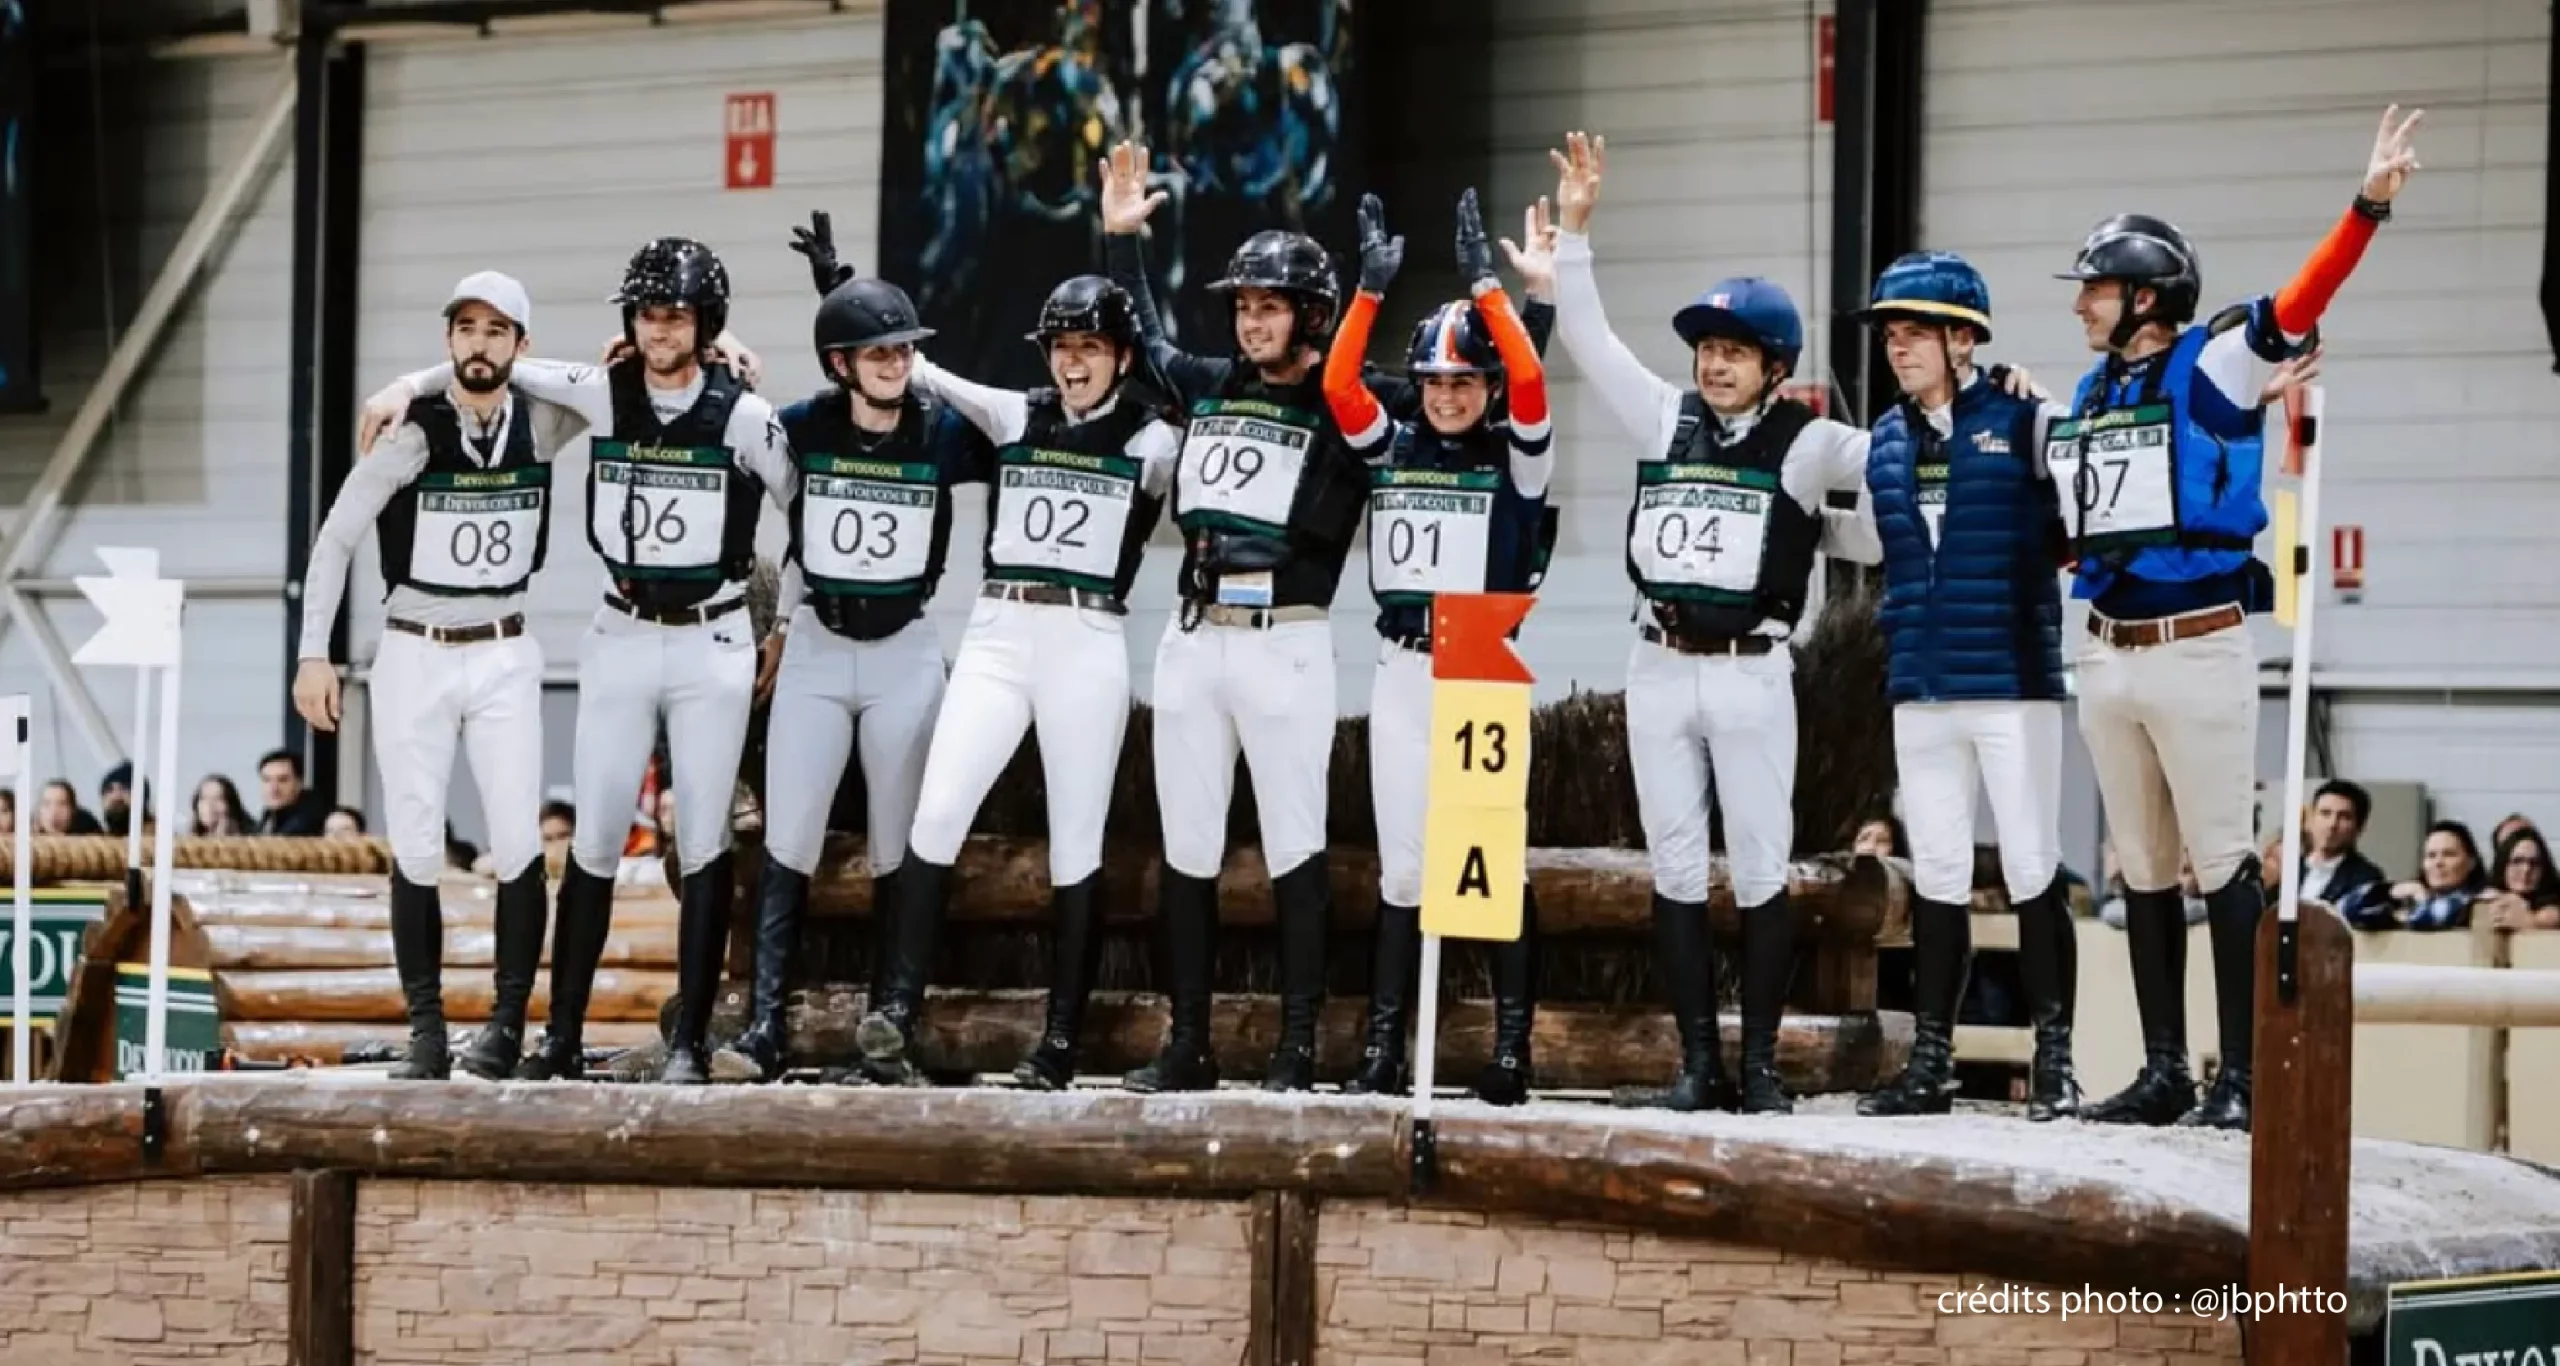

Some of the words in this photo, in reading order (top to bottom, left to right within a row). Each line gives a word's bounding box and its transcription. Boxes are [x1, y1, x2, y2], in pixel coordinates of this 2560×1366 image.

[1201, 442, 1265, 490] 09
[2073, 459, 2131, 512] 07
[449, 519, 513, 567] 08
[620, 493, 688, 544] 06
[830, 508, 899, 560] 03
[1023, 494, 1091, 547] 02
[1387, 518, 1442, 567] 01
[1656, 512, 1724, 563] 04
[1454, 720, 1507, 773] 13
[1456, 846, 1492, 899] A
